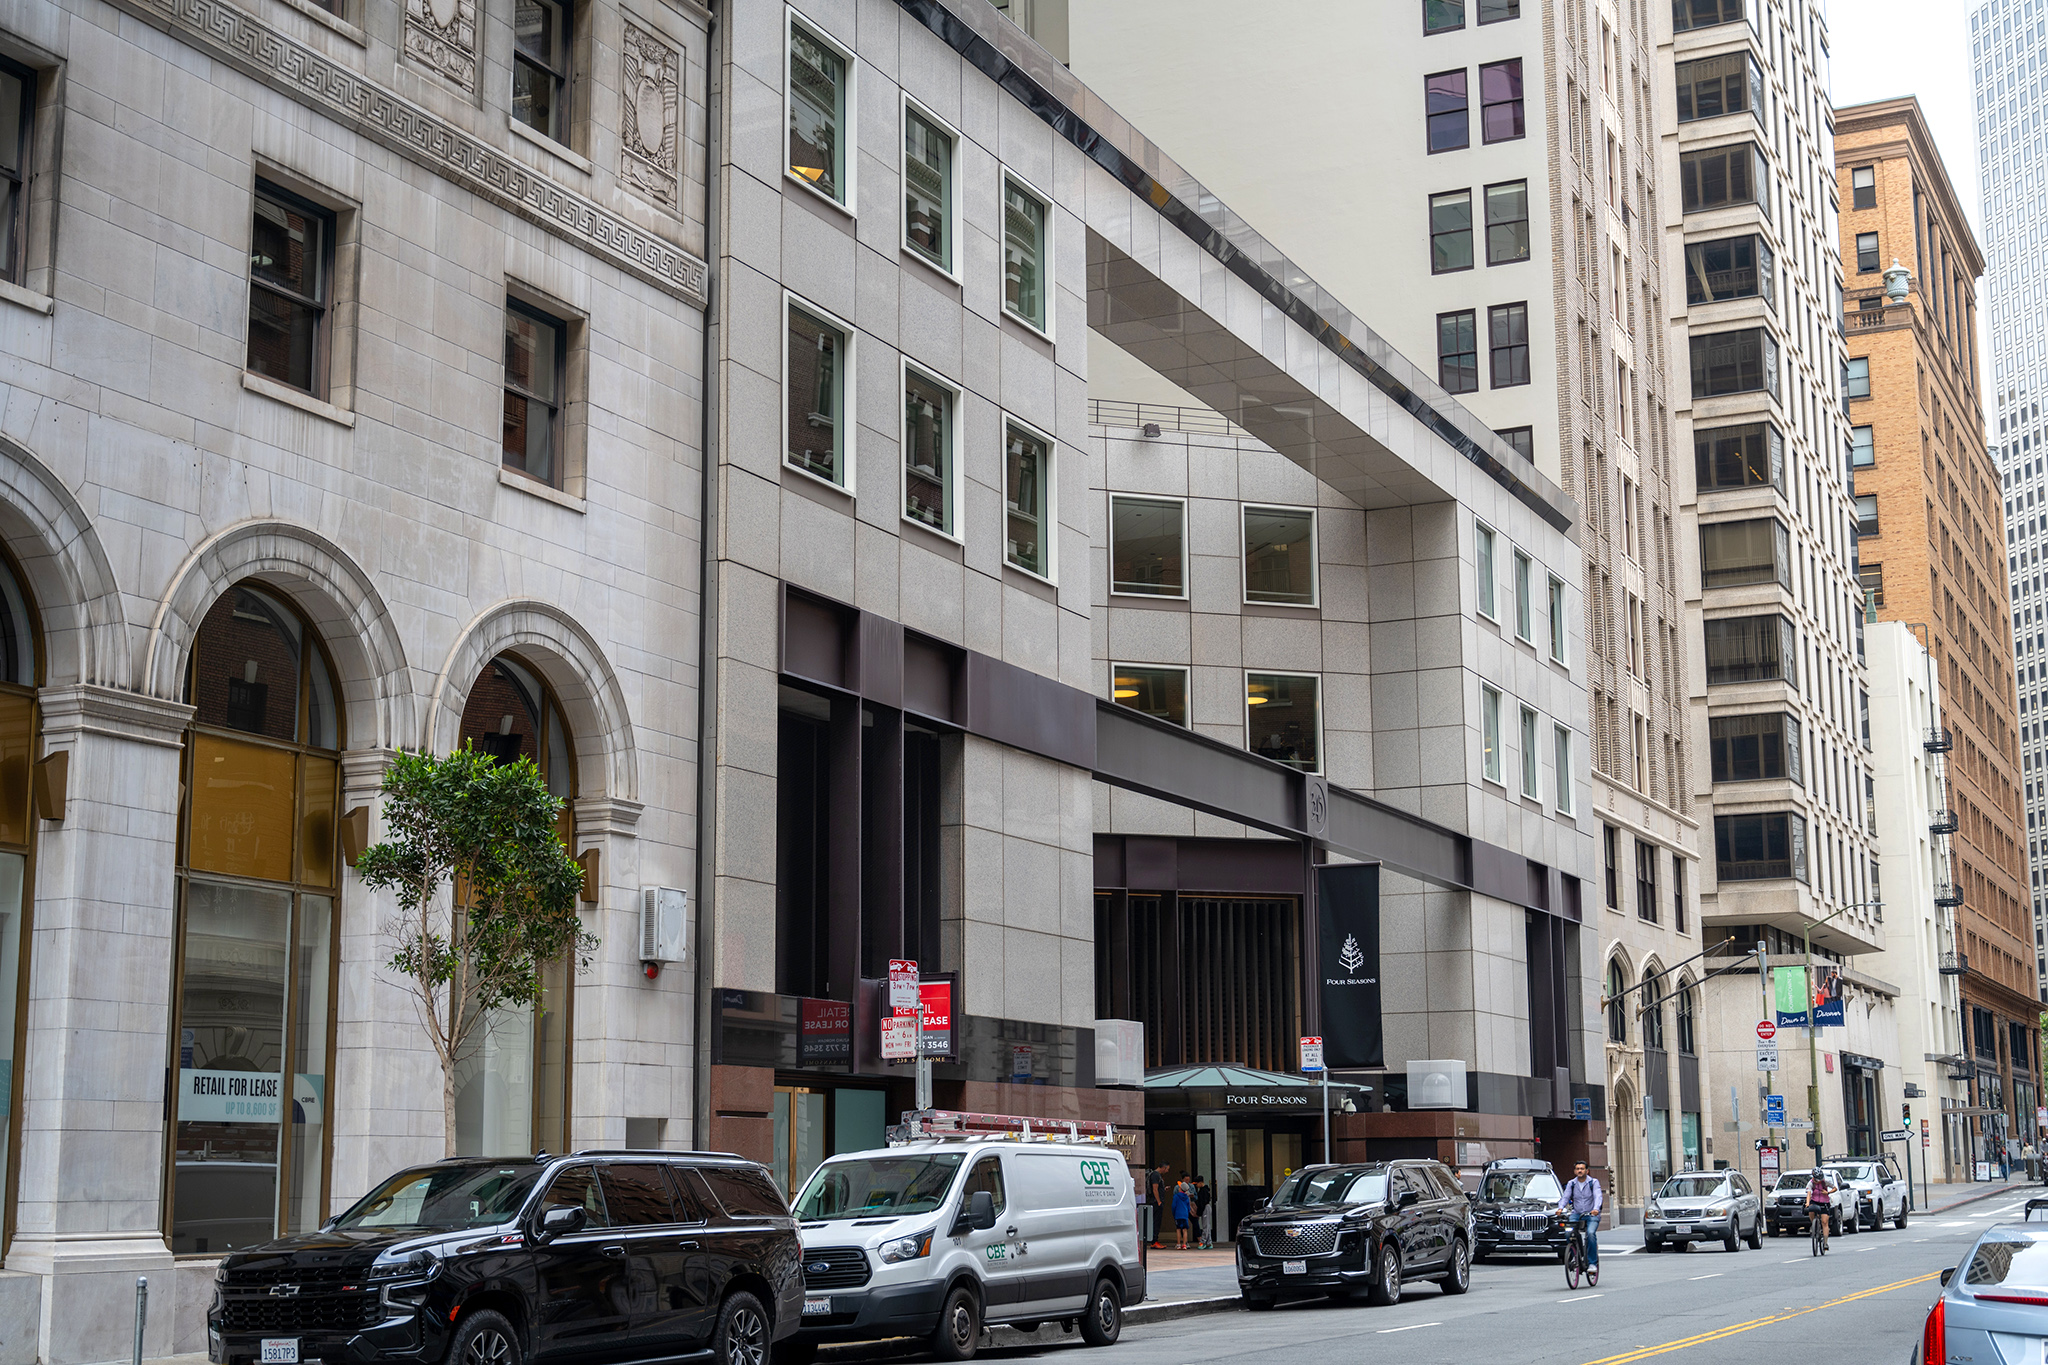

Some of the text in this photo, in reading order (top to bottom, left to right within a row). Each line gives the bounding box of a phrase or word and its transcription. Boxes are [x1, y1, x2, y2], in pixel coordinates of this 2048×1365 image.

[882, 1018, 914, 1030] NO PARKING
[924, 1016, 948, 1025] EASE
[927, 1041, 948, 1049] 3546
[193, 1076, 278, 1098] RETAIL FOR LEASE
[1226, 1094, 1308, 1105] FOUR SEASONS
[225, 1101, 277, 1117] UP TO 8,600 SF
[1080, 1160, 1110, 1185] CBF
[986, 1243, 1006, 1259] CBF
[263, 1347, 297, 1360] 15817P3
